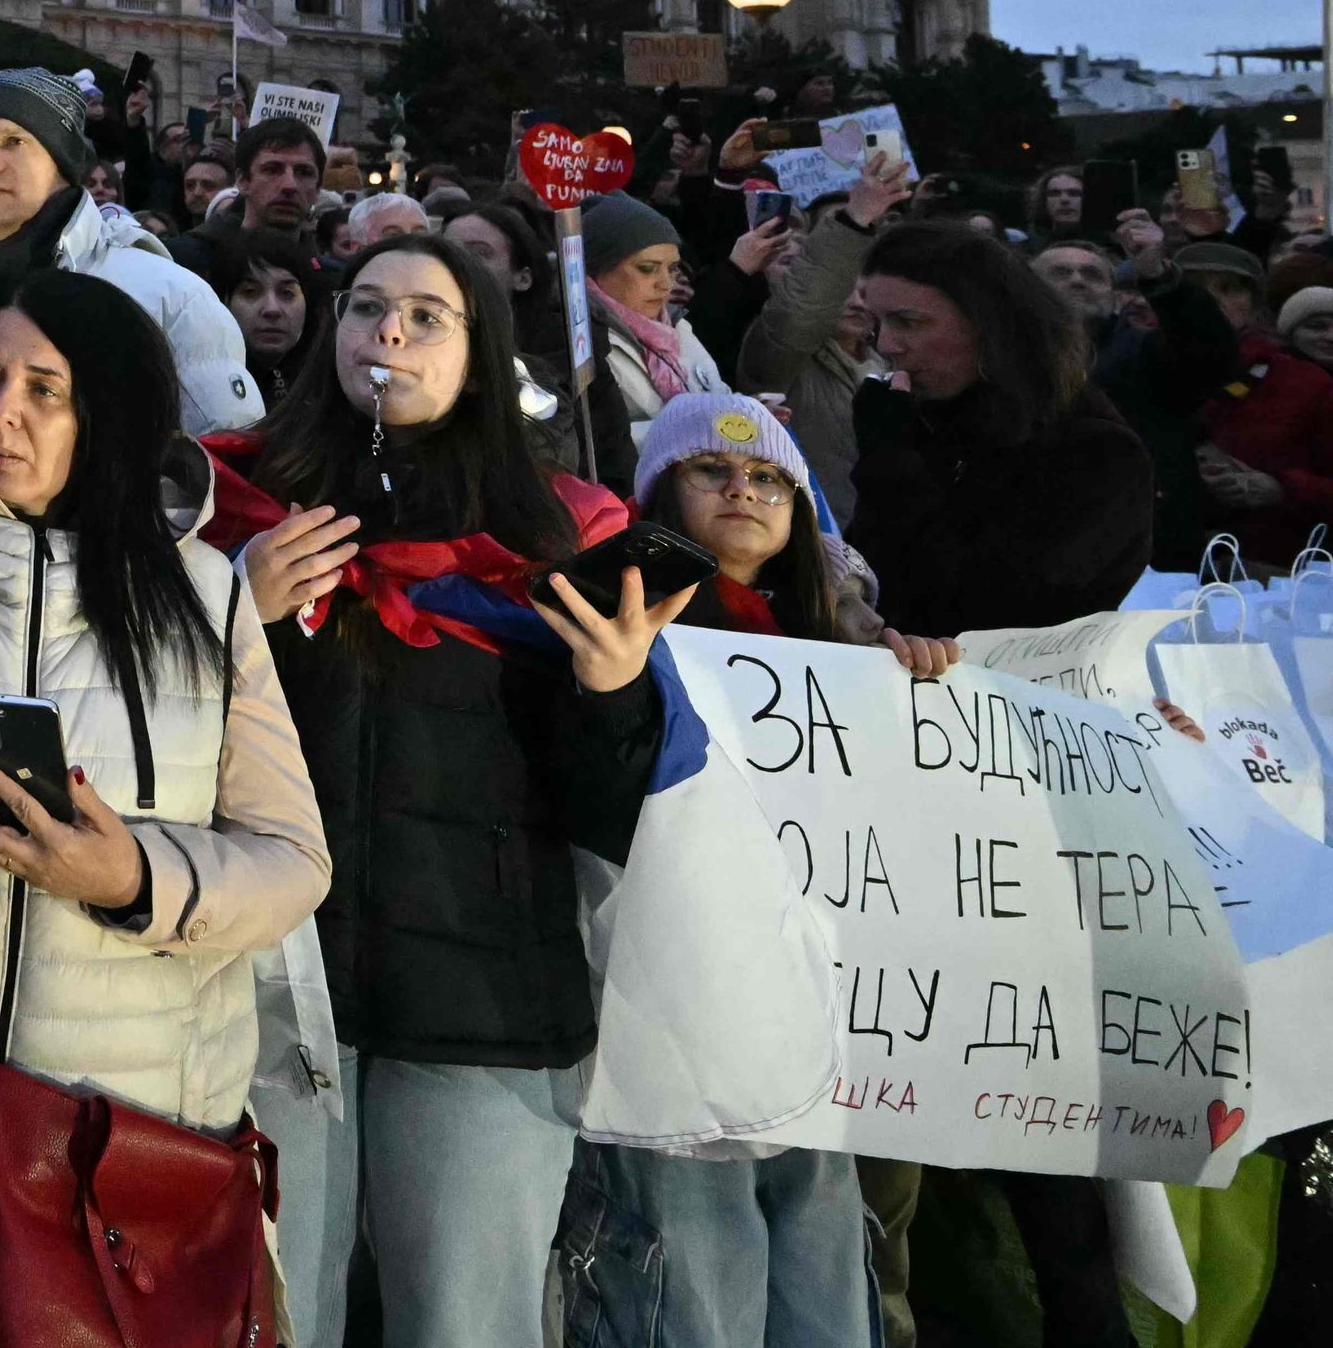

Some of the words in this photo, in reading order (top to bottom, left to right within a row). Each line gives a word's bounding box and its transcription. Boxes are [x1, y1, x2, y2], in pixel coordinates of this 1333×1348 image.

[264, 93, 275, 105] VI
[276, 96, 296, 109] STE
[532, 130, 583, 154] SAMO
[543, 150, 590, 171] LJUBAV
[564, 168, 584, 183] DA
[727, 653, 852, 776] ЗА
[910, 678, 1164, 818] БУДУЋНОСТ
[1219, 715, 1279, 741] blokada
[1242, 757, 1292, 785] Beč
[777, 820, 899, 916] ОЈА
[955, 833, 1027, 918] НЕ
[1056, 850, 1206, 937] ТЕРА
[834, 962, 940, 1056] ЦУ
[964, 981, 1060, 1069] ДА
[1099, 989, 1253, 1090] БЕЖЕ!
[830, 1075, 919, 1114] ШКА
[973, 1092, 1197, 1141] СТУДЕНТИМА!
